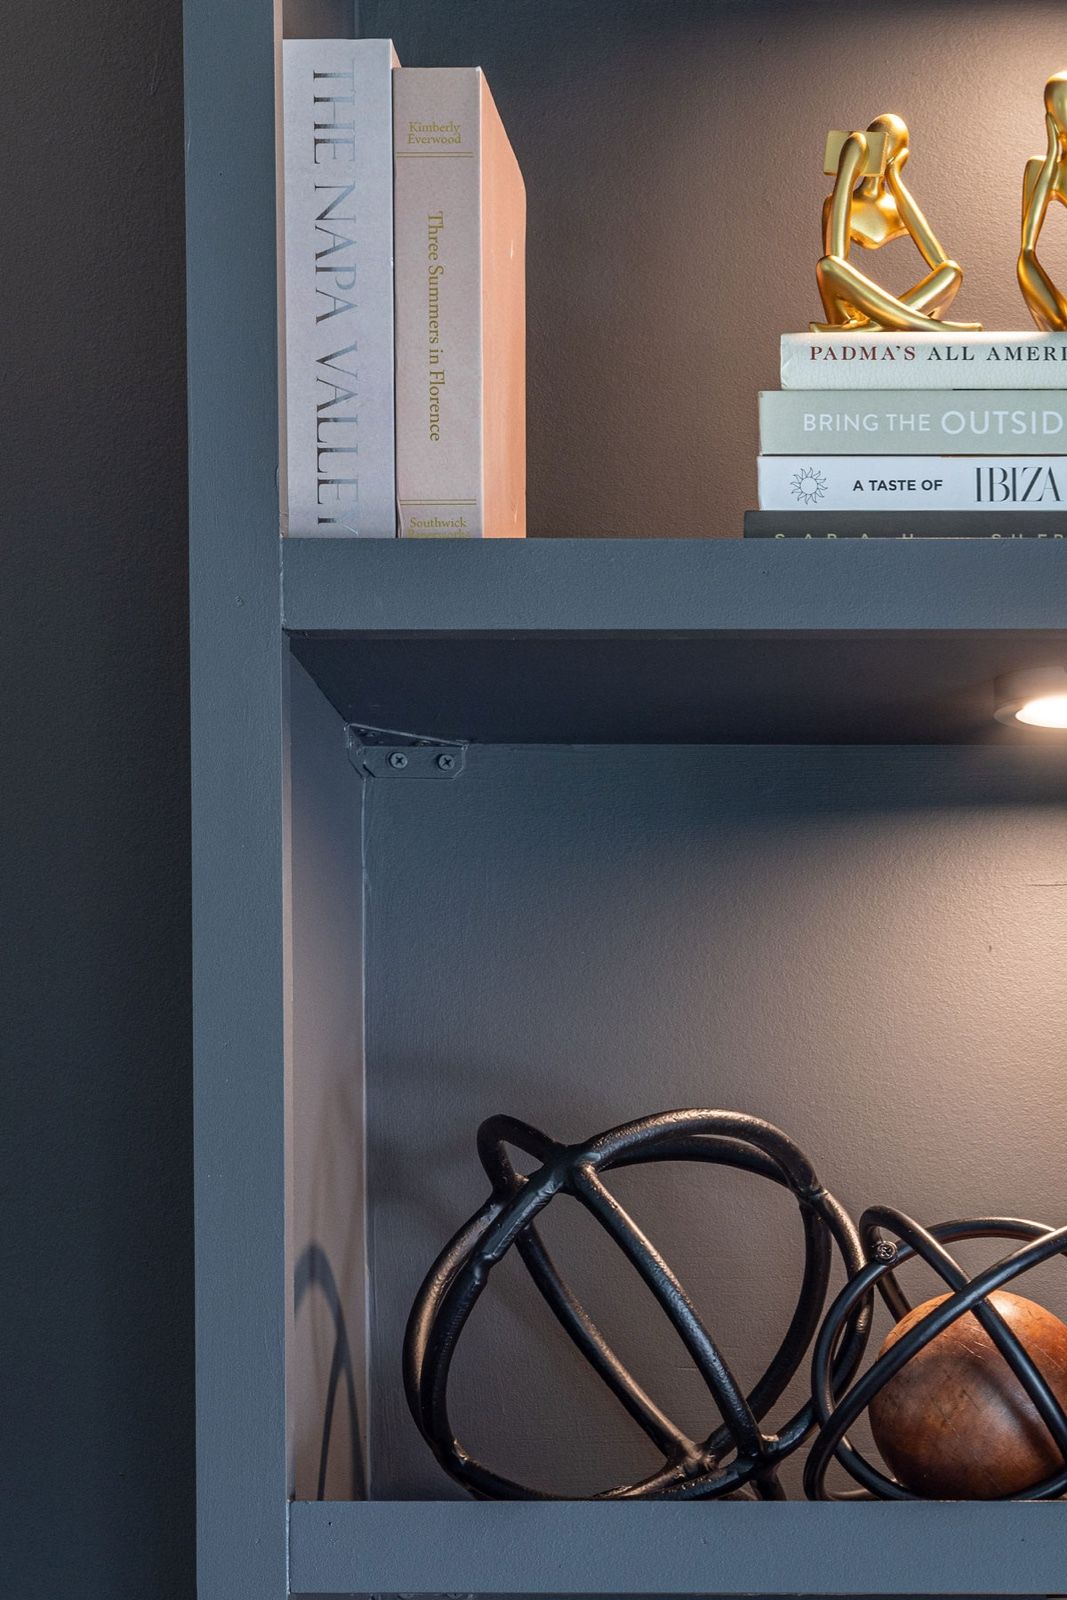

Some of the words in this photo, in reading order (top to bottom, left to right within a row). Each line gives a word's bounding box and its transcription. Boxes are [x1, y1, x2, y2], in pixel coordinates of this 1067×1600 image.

[312, 59, 357, 165] THE
[407, 121, 461, 134] Kimberly
[407, 133, 462, 145] Everwood
[427, 211, 444, 261] Three
[313, 180, 359, 325] NAPA
[428, 265, 444, 344] Summers
[429, 349, 443, 364] in
[809, 345, 916, 361] PADMA'S
[926, 346, 976, 361] ALL
[429, 369, 445, 442] Florence
[803, 413, 879, 432] BRING
[885, 413, 931, 432] THE
[315, 340, 360, 537] VALLEY
[852, 480, 864, 491] A
[868, 480, 917, 491] TASTE
[921, 479, 943, 491] OF
[975, 466, 1064, 503] IBIZA
[409, 516, 467, 528] Southwick
